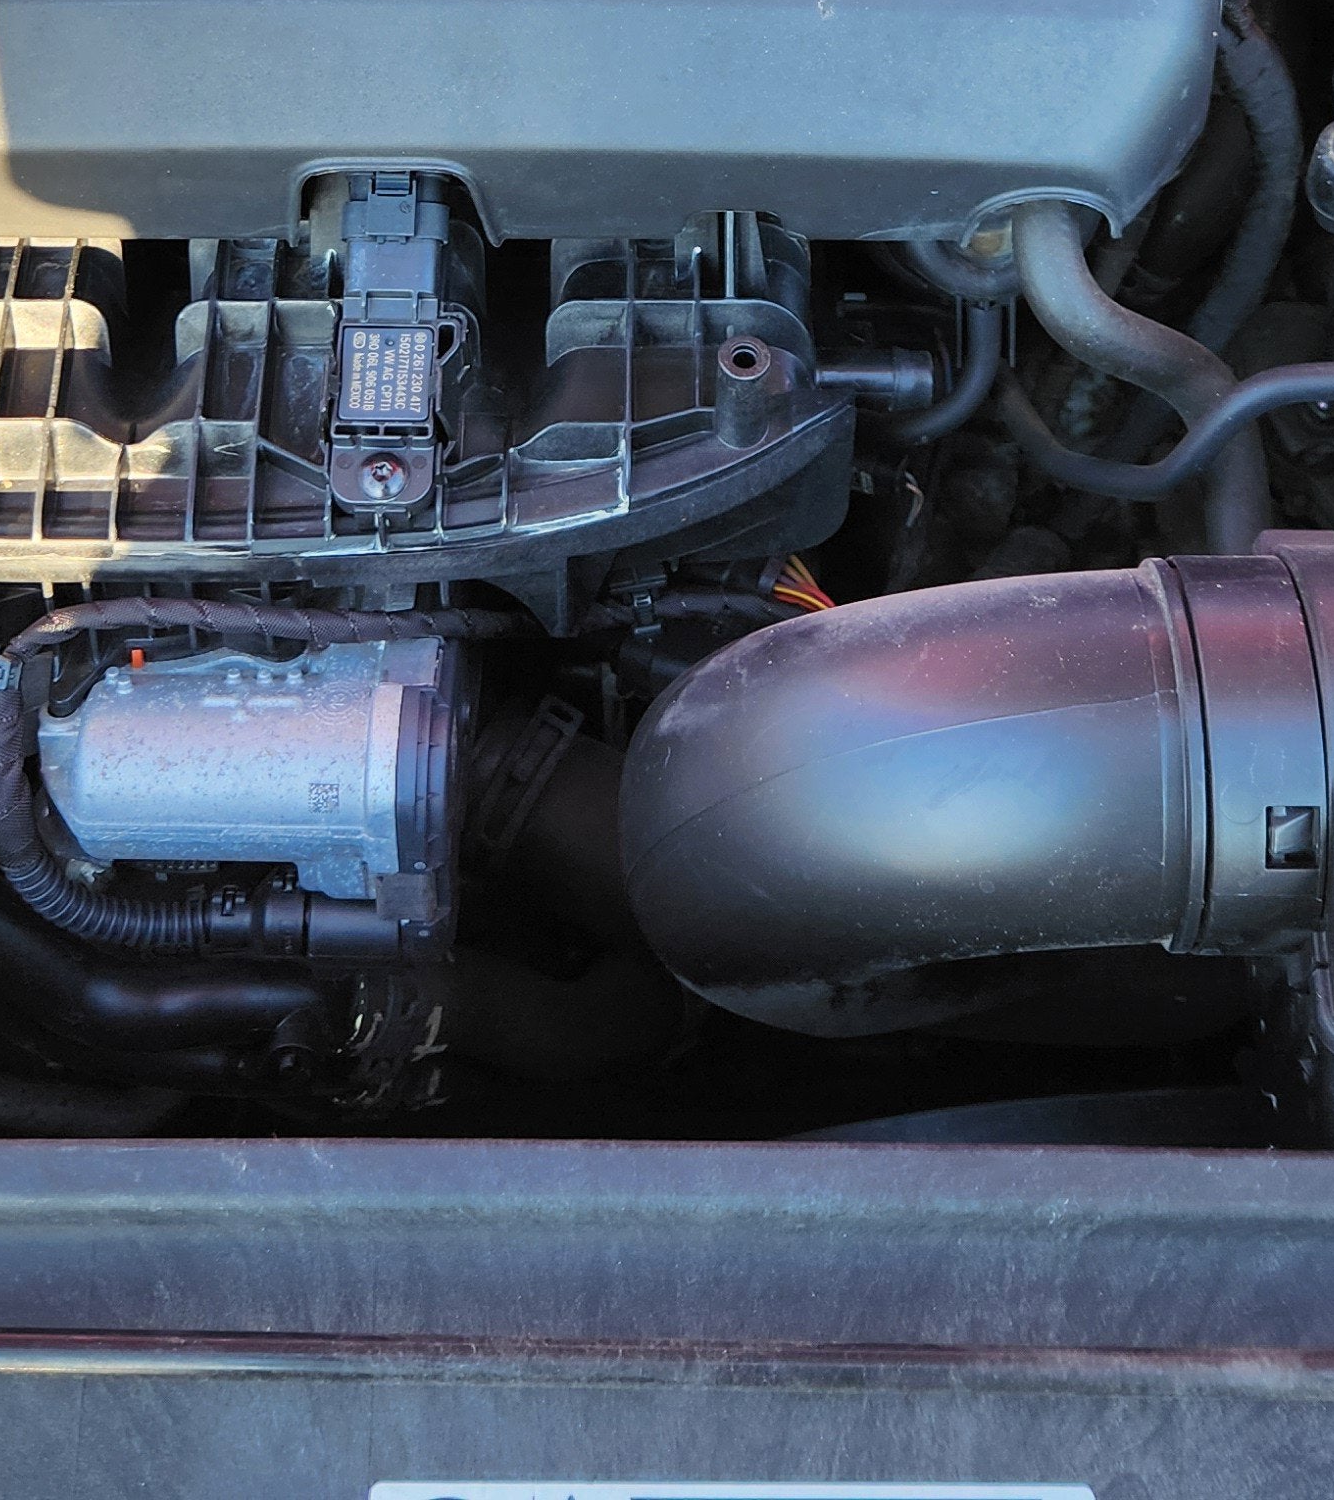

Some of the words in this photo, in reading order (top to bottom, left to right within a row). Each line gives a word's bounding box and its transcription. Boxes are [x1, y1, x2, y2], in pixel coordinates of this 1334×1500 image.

[383, 349, 396, 365] VW
[412, 353, 425, 371] 261
[352, 372, 362, 380] in
[382, 366, 394, 381] AG
[410, 373, 423, 393] 230
[348, 380, 362, 409] MEXICO
[409, 395, 422, 413] 417
